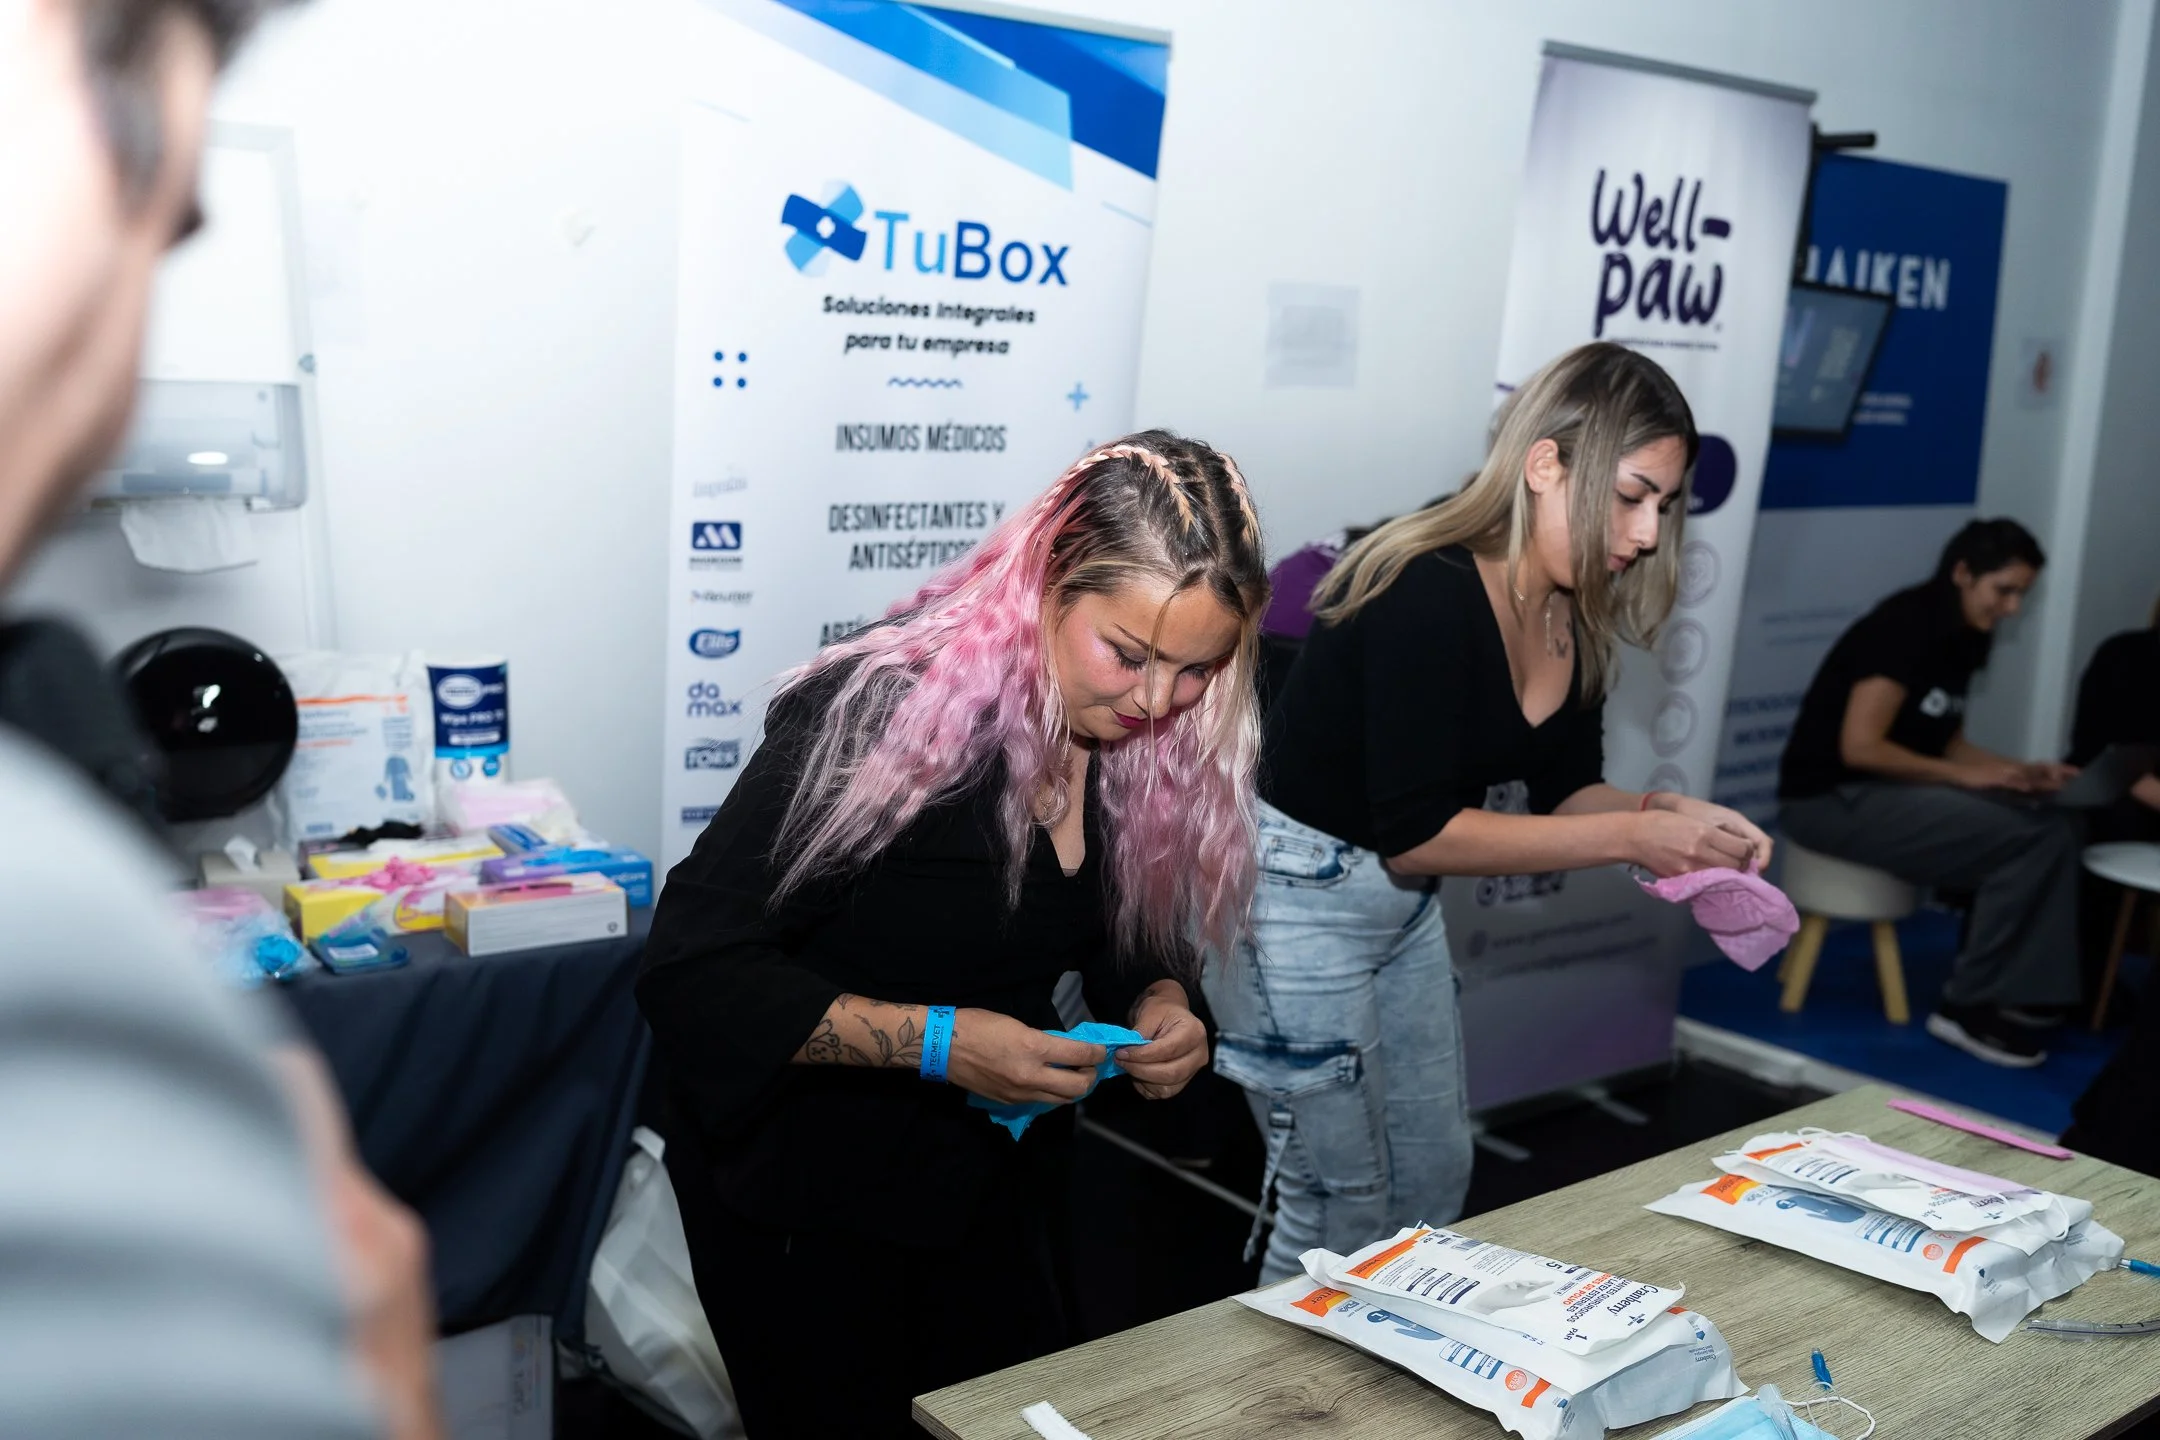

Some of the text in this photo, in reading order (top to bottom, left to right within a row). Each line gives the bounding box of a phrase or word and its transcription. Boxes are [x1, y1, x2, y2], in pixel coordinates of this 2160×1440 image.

[1591, 169, 1732, 253] Well-
[874, 211, 1069, 286] TuBox
[823, 295, 930, 318] Soluciones
[1594, 253, 1723, 338] paw
[843, 333, 1011, 359] para tu empresa
[836, 418, 1008, 452] INSUMOS MÉDICOS
[828, 502, 988, 533] DESINFECTANTES
[848, 535, 978, 570] ANTISÉPTIC
[929, 1023, 941, 1067] TECMEVET
[1607, 1284, 1659, 1314] Cranberry
